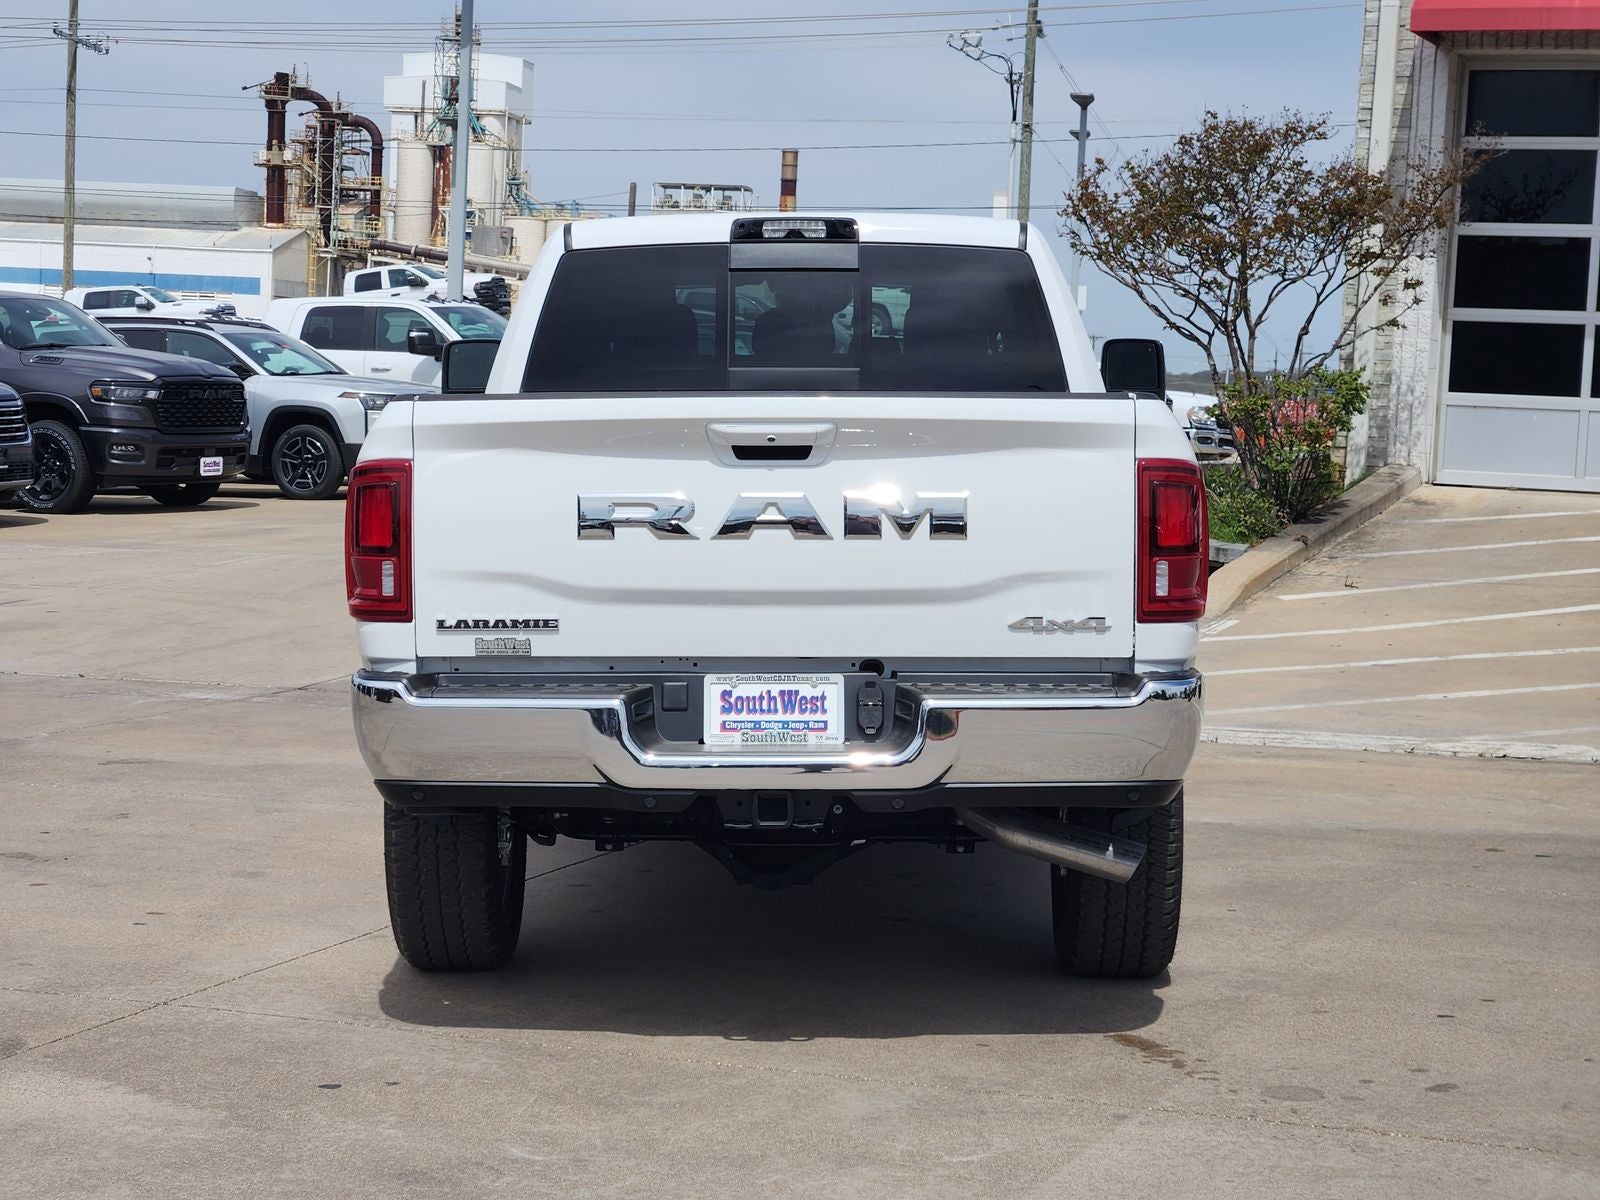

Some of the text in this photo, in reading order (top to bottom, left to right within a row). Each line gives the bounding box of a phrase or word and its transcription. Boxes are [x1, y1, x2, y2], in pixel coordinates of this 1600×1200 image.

[577, 491, 969, 541] RAM
[436, 619, 559, 631] LARAMIE
[475, 638, 531, 649] SouthWest
[719, 689, 828, 716] SouthWest
[725, 721, 825, 731] Chrysler Dodge Jeep Ram
[741, 731, 808, 743] SouthWest
